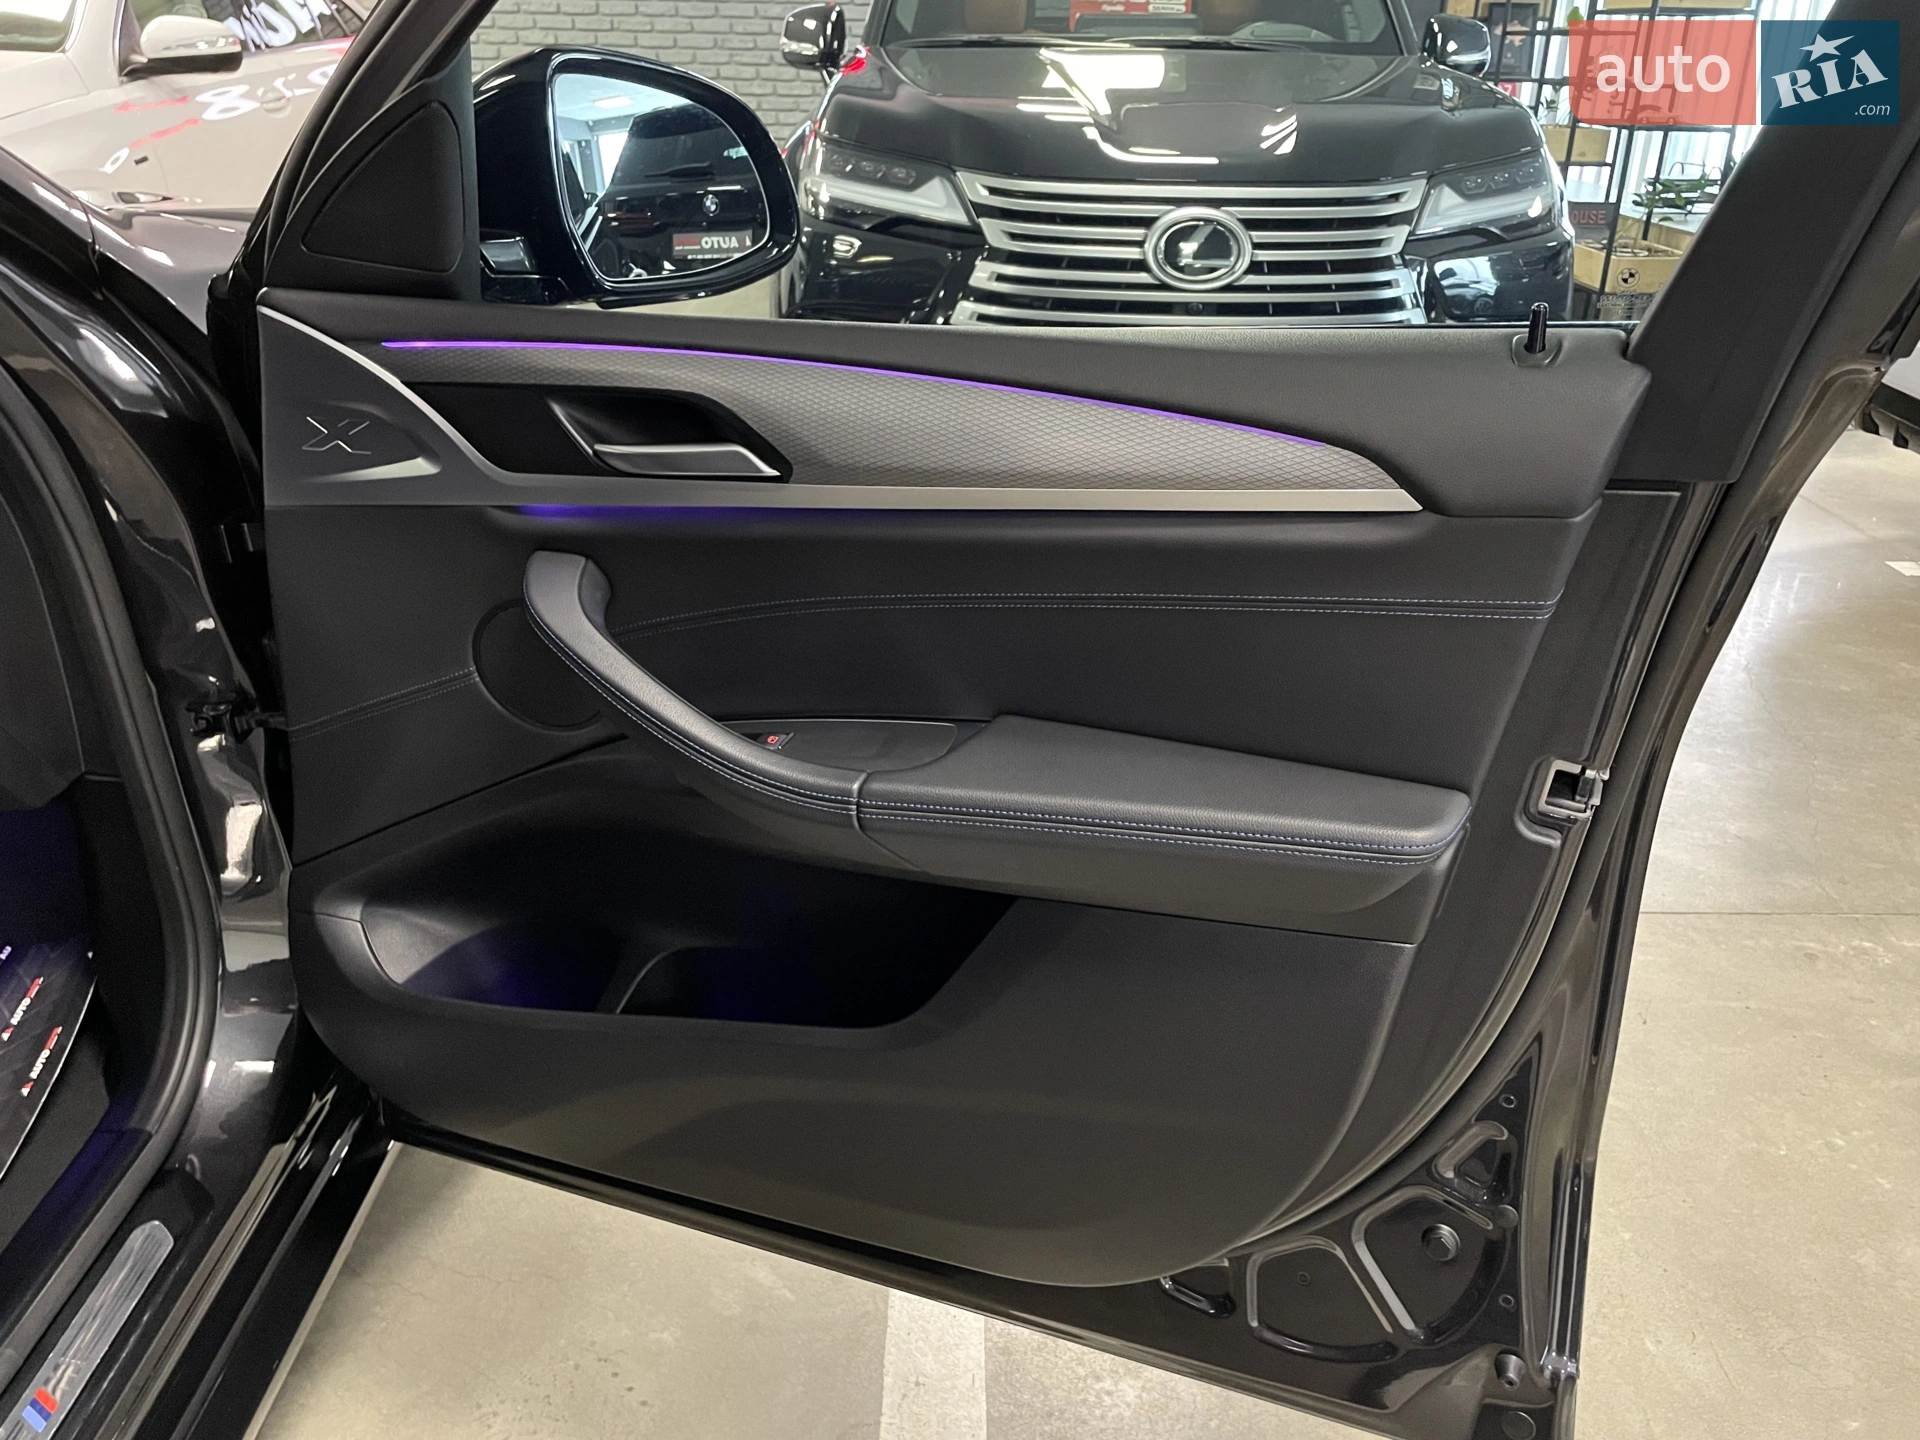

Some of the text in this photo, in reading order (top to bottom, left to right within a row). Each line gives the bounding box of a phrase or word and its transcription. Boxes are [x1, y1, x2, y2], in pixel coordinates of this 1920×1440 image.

[1570, 210, 1606, 224] OUSE
[10, 997, 31, 1025] AUTO
[29, 1048, 51, 1079] AUTO
